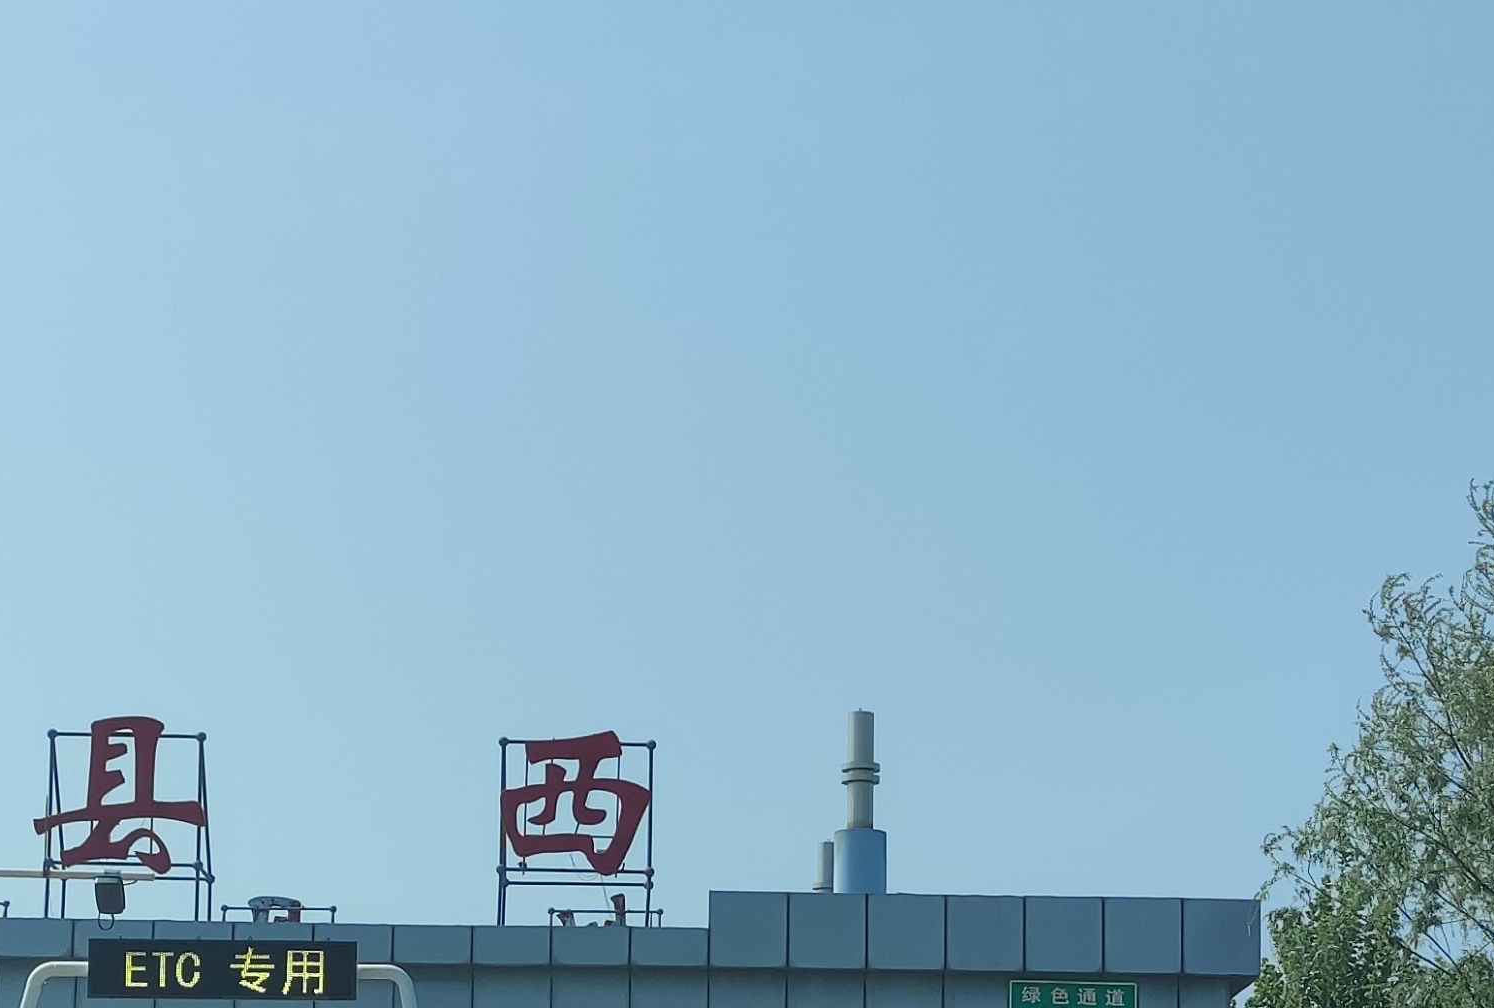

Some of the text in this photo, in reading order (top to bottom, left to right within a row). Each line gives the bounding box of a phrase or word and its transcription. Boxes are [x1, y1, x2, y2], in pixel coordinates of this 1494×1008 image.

[125, 946, 325, 995] ETC 专用
[1021, 986, 1125, 1007] 绿色通道
